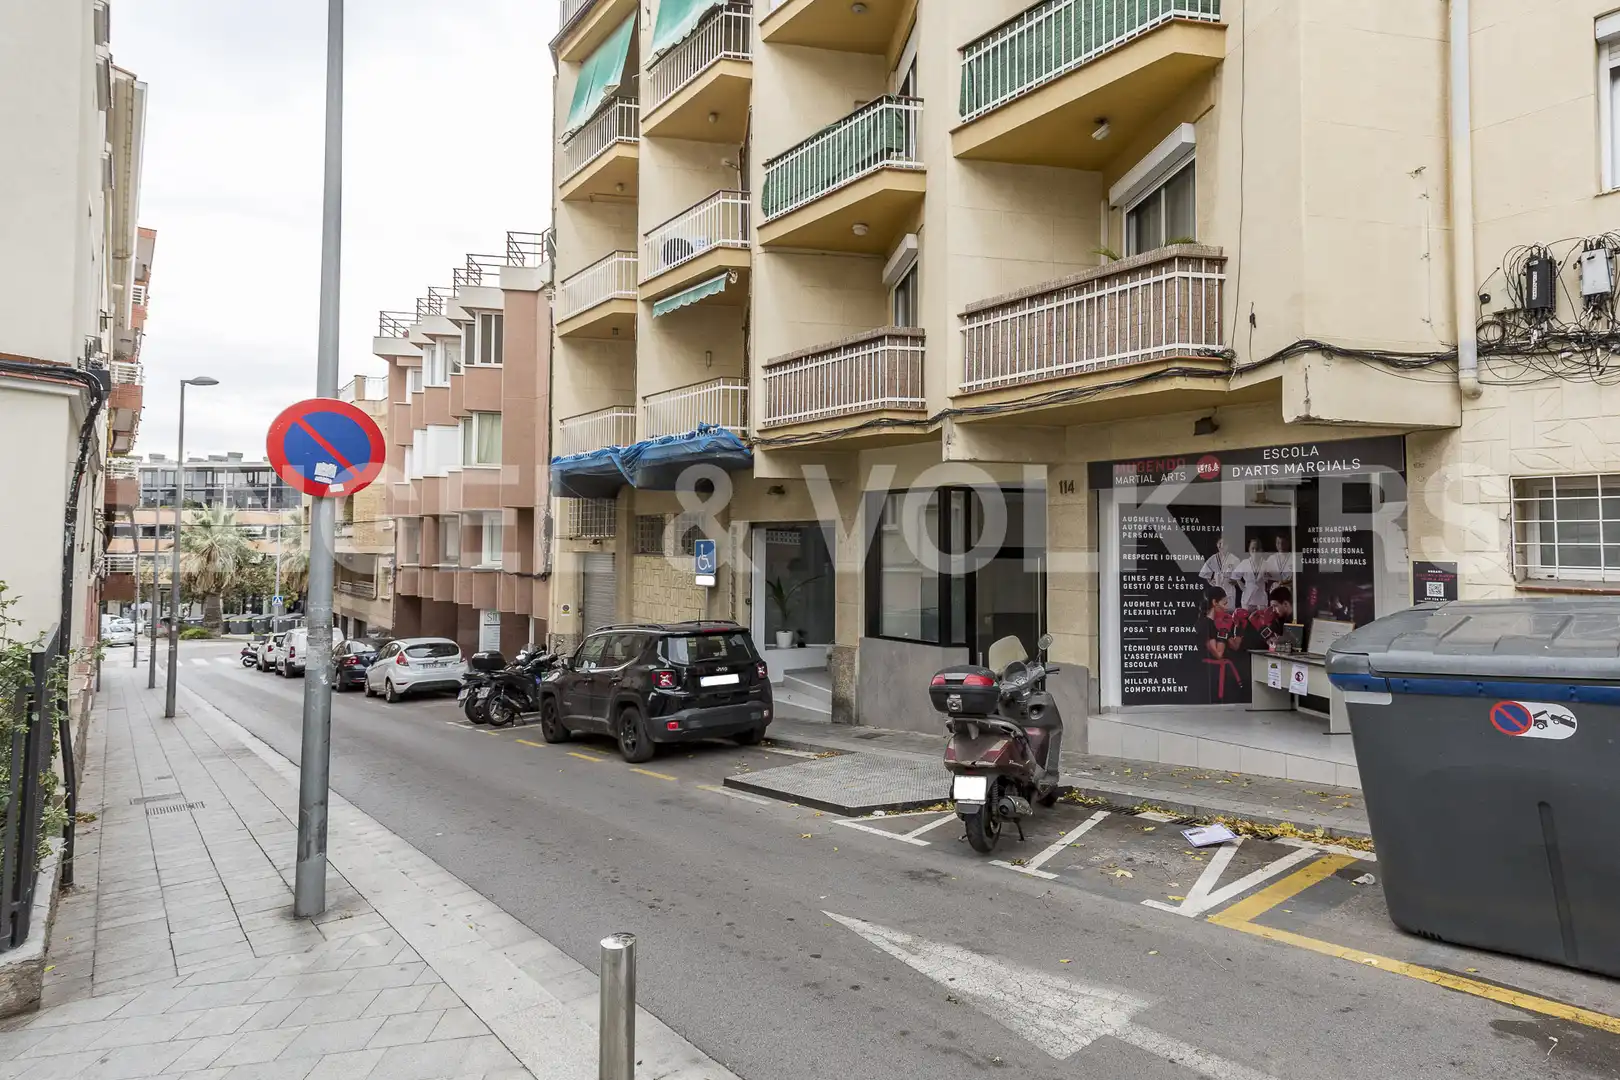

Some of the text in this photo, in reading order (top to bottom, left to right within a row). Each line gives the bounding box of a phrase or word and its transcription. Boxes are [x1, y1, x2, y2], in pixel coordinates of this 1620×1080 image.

[1263, 445, 1319, 460] ESCOLA
[1232, 464, 1279, 478] D'ARTS
[1284, 458, 1361, 474] MARCIALS
[1115, 471, 1187, 485] MARTIAL ARTS
[1059, 479, 1075, 494] 114
[1324, 525, 1357, 533] MARCIALS
[1328, 558, 1367, 566] PERSONALS
[1123, 582, 1151, 590] GESTIÓ
[1124, 685, 1189, 693] COMPORTAMENT
